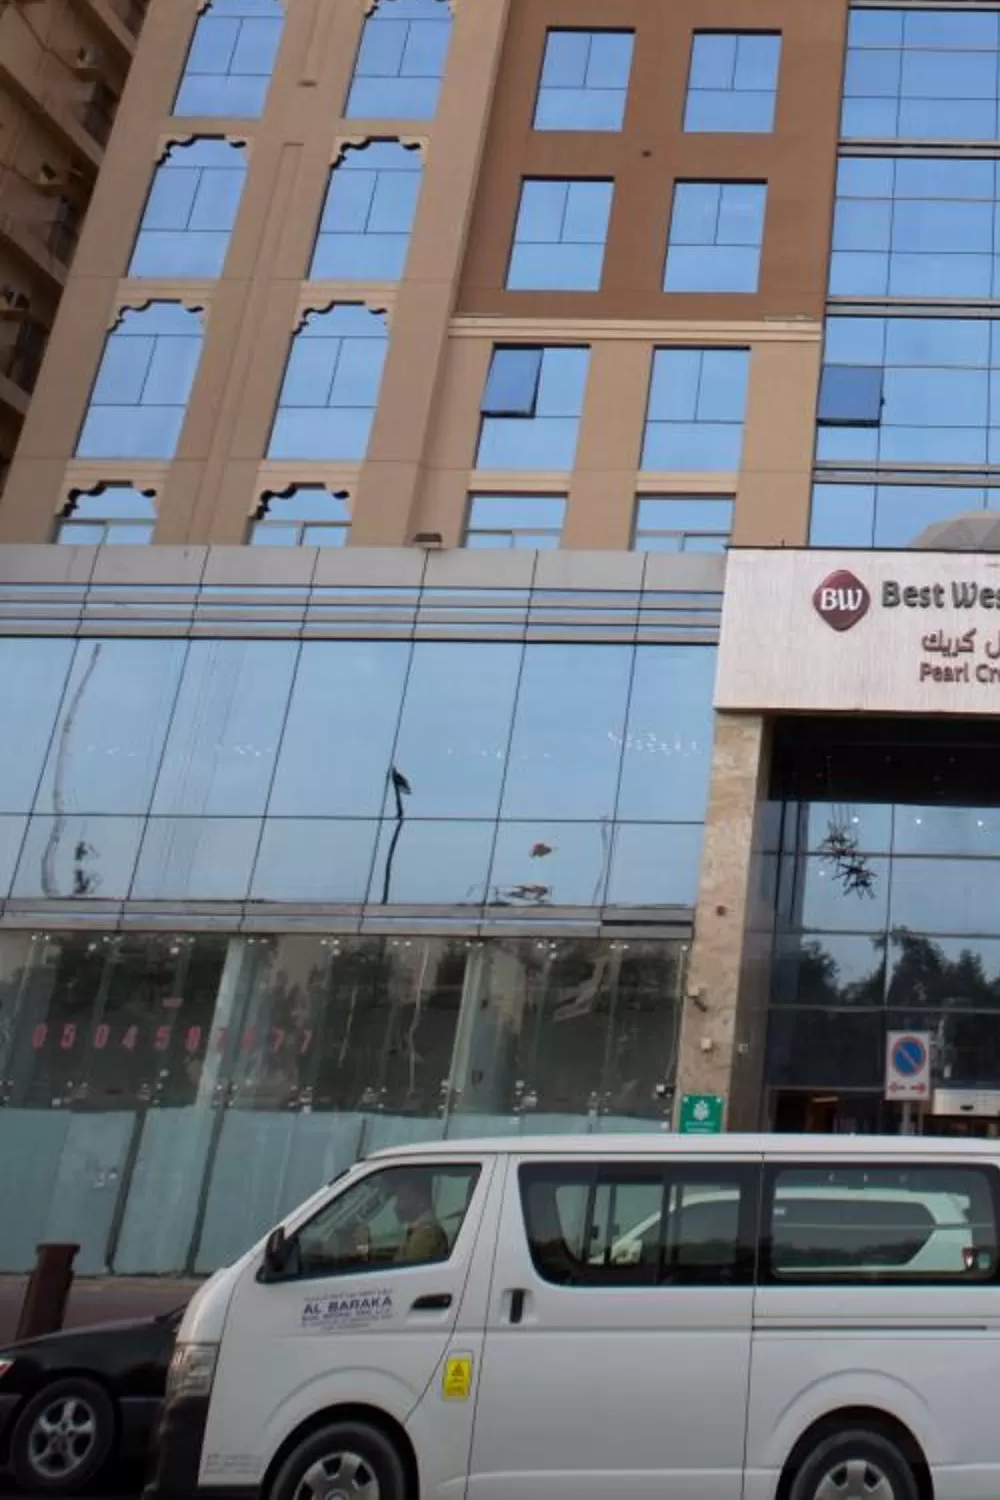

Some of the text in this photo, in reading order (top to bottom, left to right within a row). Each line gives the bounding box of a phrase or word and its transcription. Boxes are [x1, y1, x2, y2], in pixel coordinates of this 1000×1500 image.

[820, 588, 864, 612] BW
[880, 581, 945, 609] Best
[921, 628, 978, 658] كريك
[919, 662, 969, 683] Pearl
[303, 1303, 322, 1315] AL
